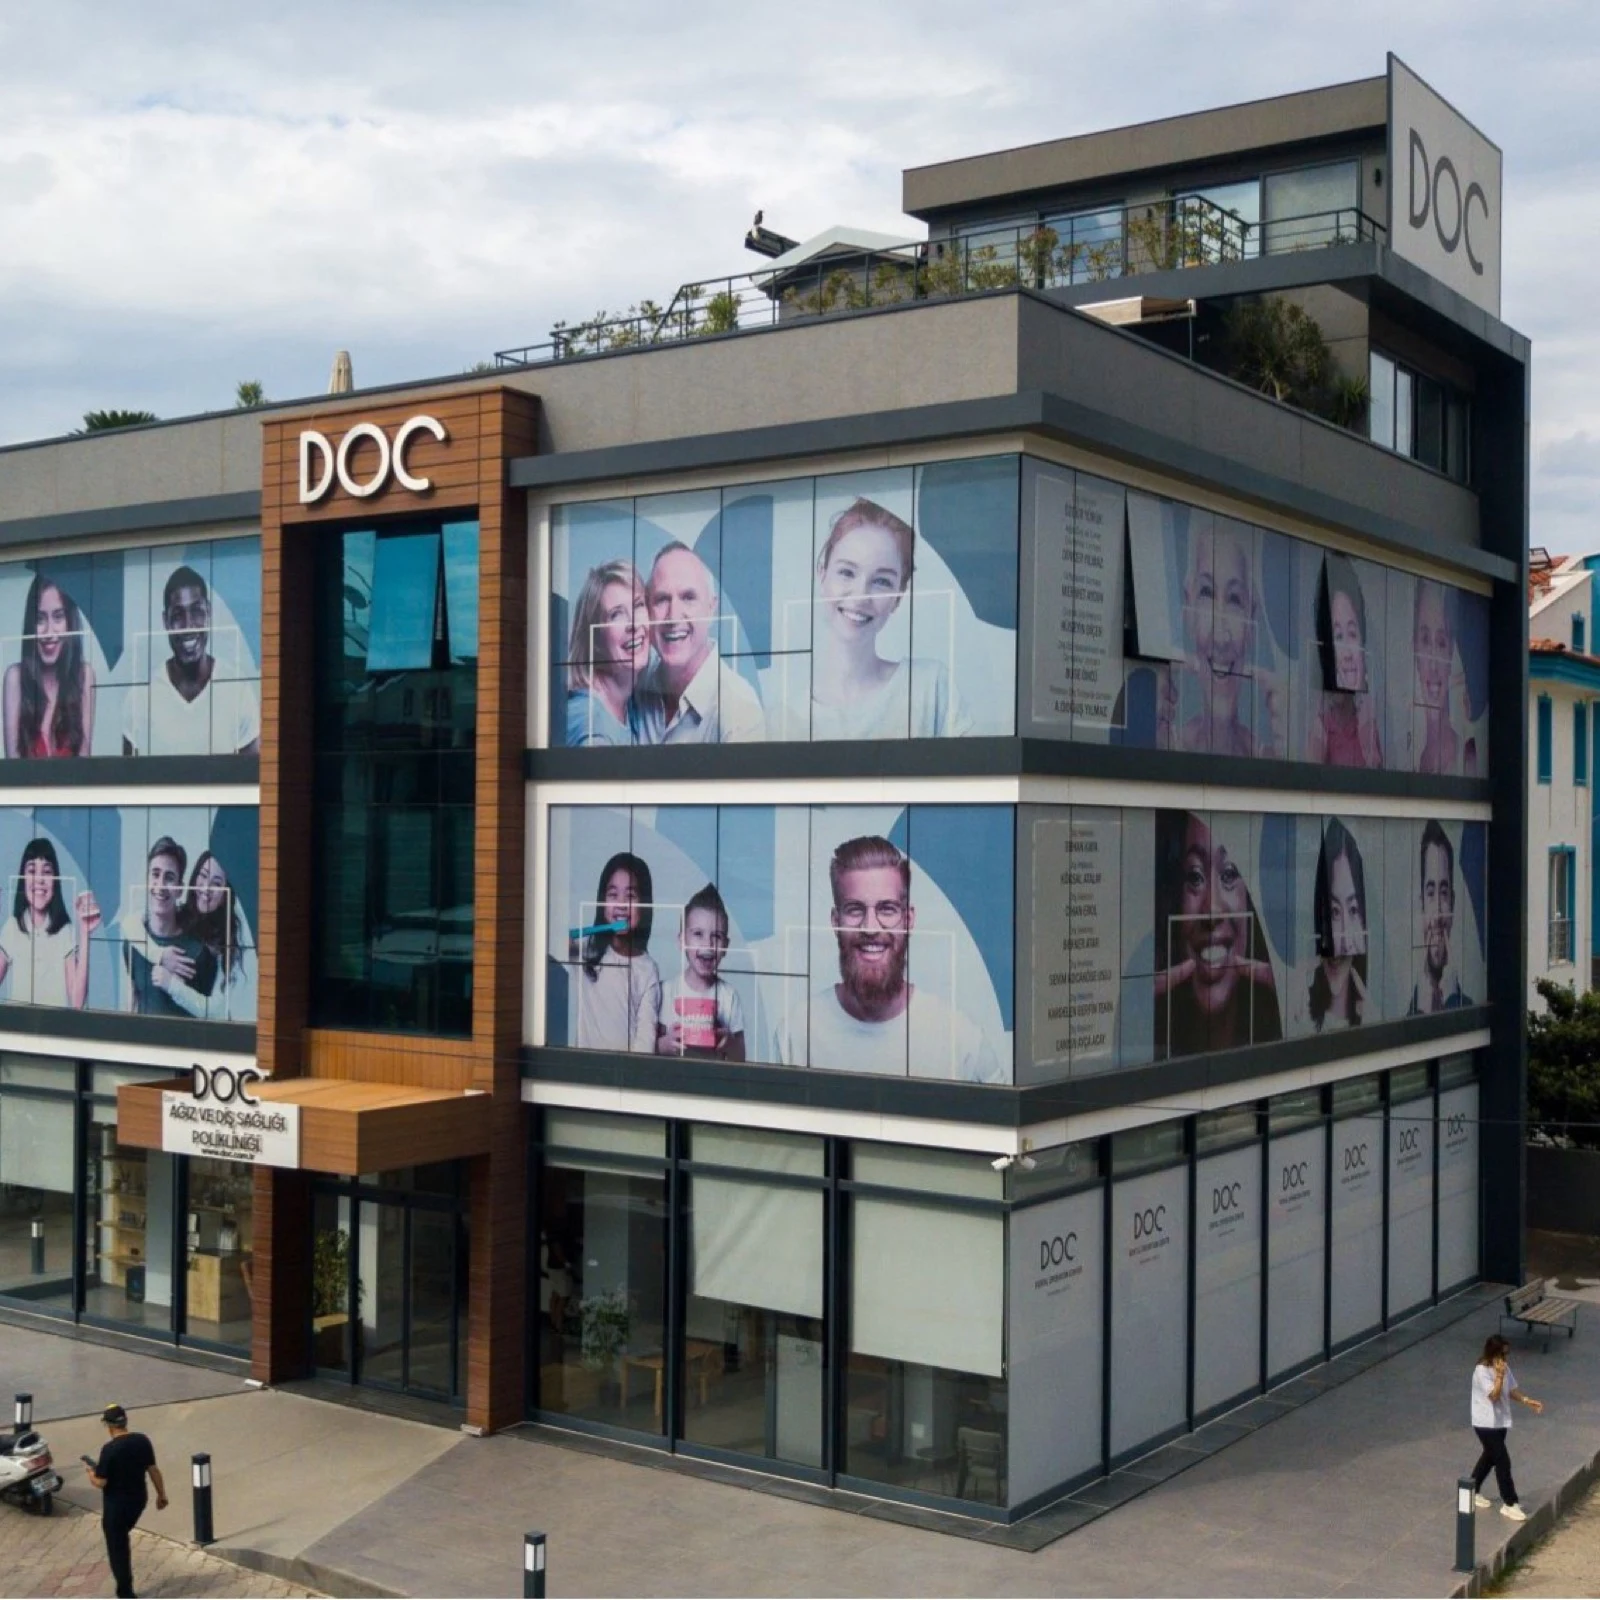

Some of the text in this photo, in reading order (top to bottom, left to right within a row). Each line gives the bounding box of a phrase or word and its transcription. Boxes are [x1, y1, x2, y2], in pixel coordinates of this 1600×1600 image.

[1409, 127, 1488, 276] DOC
[299, 415, 446, 504] DOC
[192, 1063, 259, 1105] DOC
[170, 1103, 288, 1132] AĞIZ VE DİŞ SAĞLIĞI
[192, 1129, 262, 1153] POLİKLİNİĞİ
[1399, 1127, 1421, 1153] DOC
[1344, 1143, 1368, 1171] DOC
[1282, 1162, 1308, 1191] DOC
[1213, 1182, 1242, 1214] DOC
[1134, 1205, 1166, 1239] DOC
[1040, 1231, 1077, 1270] DOC
